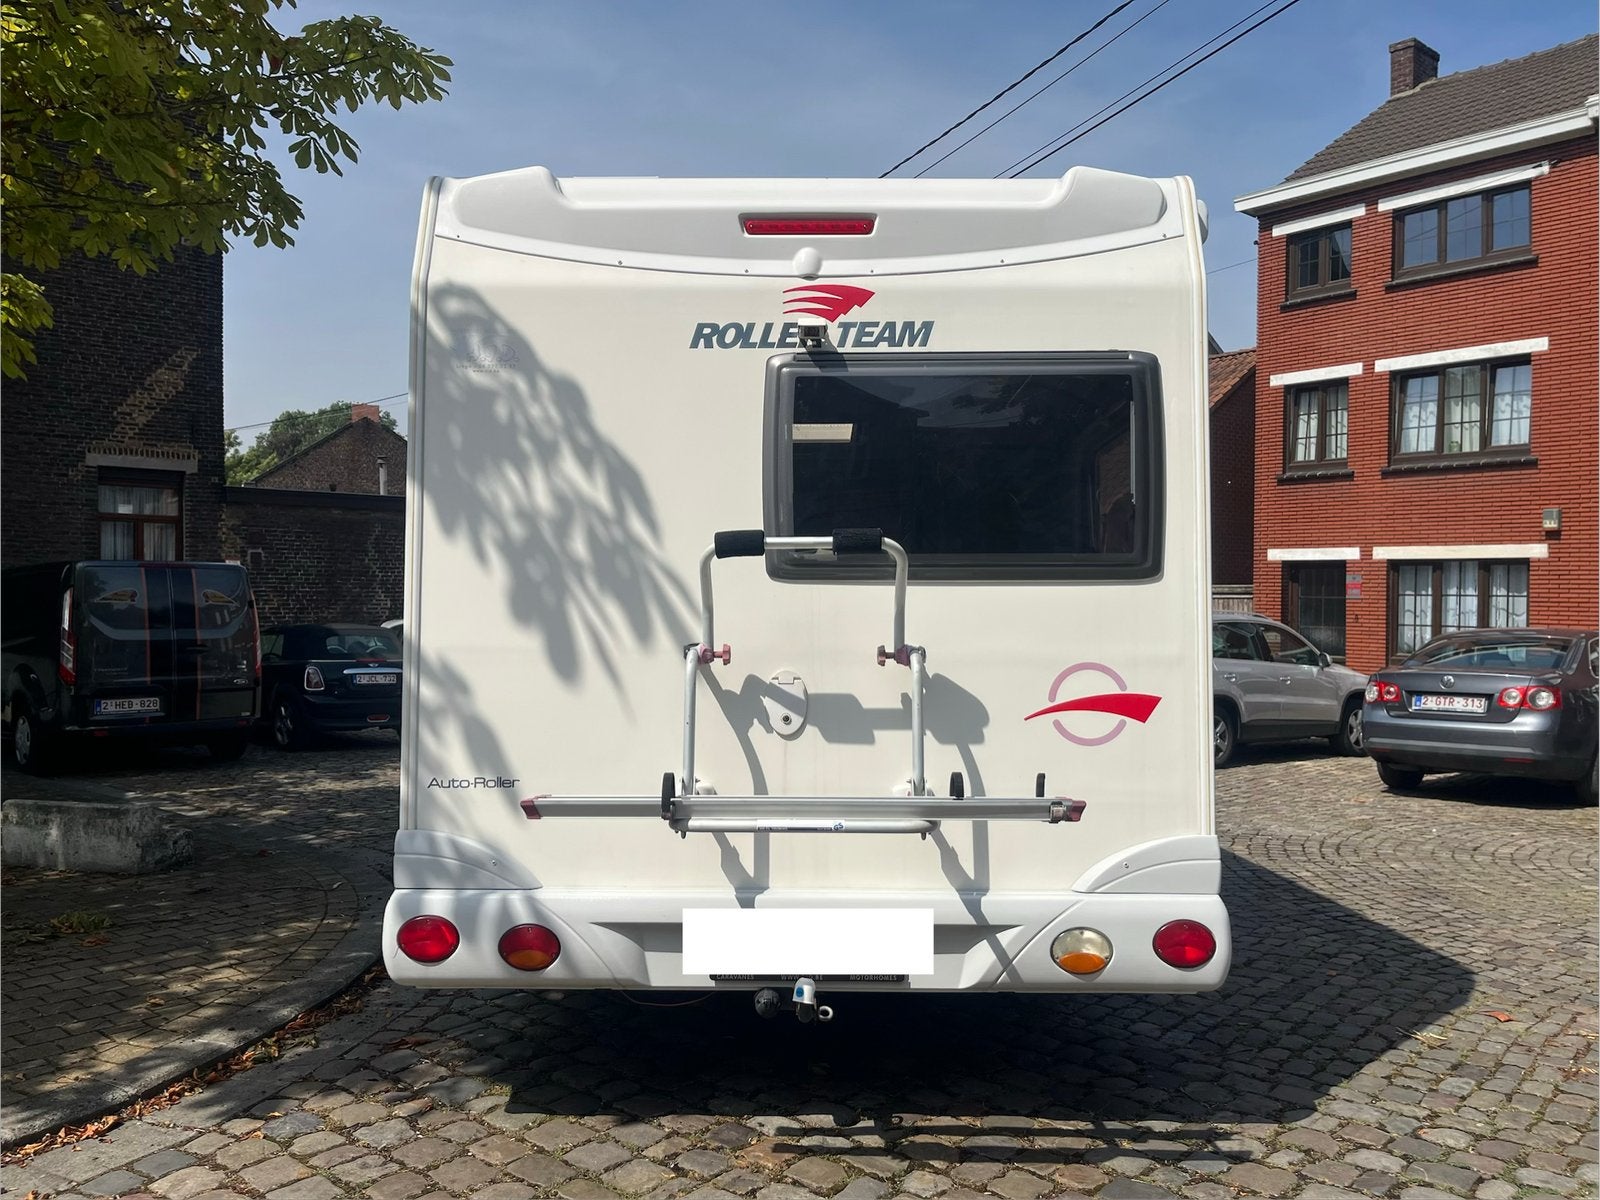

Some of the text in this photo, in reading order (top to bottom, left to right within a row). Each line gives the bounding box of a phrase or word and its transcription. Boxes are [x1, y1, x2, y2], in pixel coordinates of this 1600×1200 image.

[689, 320, 935, 349] ROLLE TEAM
[1422, 695, 1484, 709] 2-GTR-313
